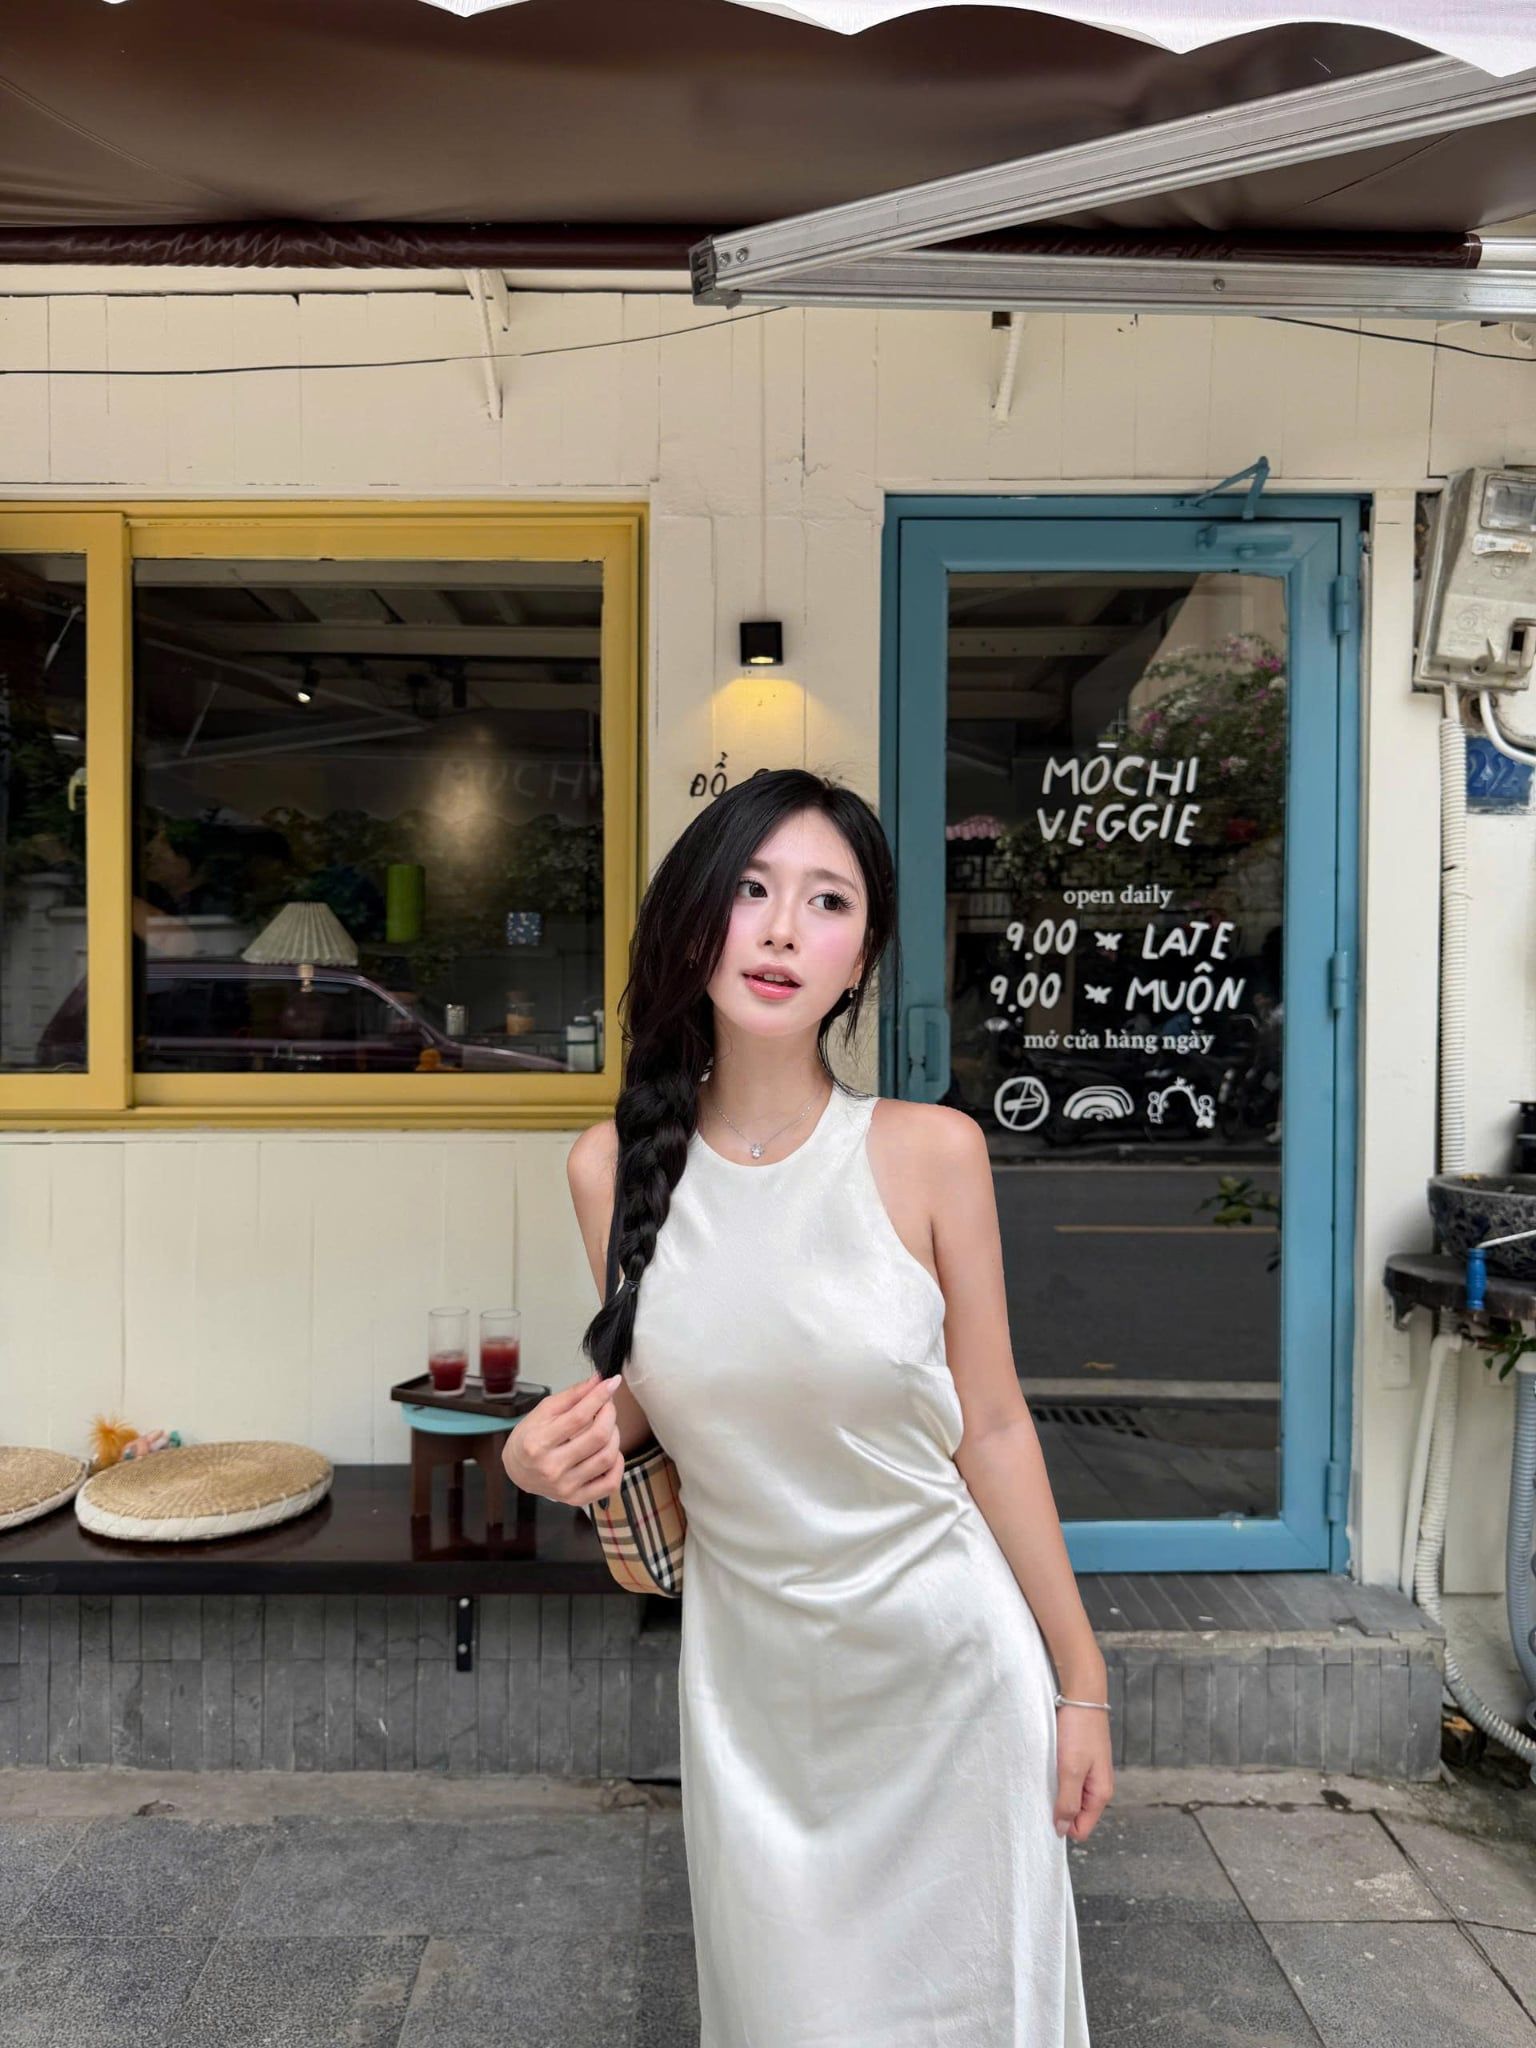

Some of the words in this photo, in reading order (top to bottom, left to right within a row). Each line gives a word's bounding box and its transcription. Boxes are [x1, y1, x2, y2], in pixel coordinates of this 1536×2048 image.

[1036, 803, 1201, 847] VEGGIE
[1063, 889, 1115, 910] open
[1119, 884, 1173, 909] daily
[1006, 918, 1078, 961] 9.00
[1141, 921, 1235, 961] LATE
[989, 972, 1062, 1013] 9.00
[1125, 962, 1246, 1024] MUỘN
[1023, 1029, 1060, 1049] mở
[1062, 1028, 1100, 1050] cửa
[1104, 1028, 1158, 1054] hàng
[1162, 1029, 1215, 1054] ngày
